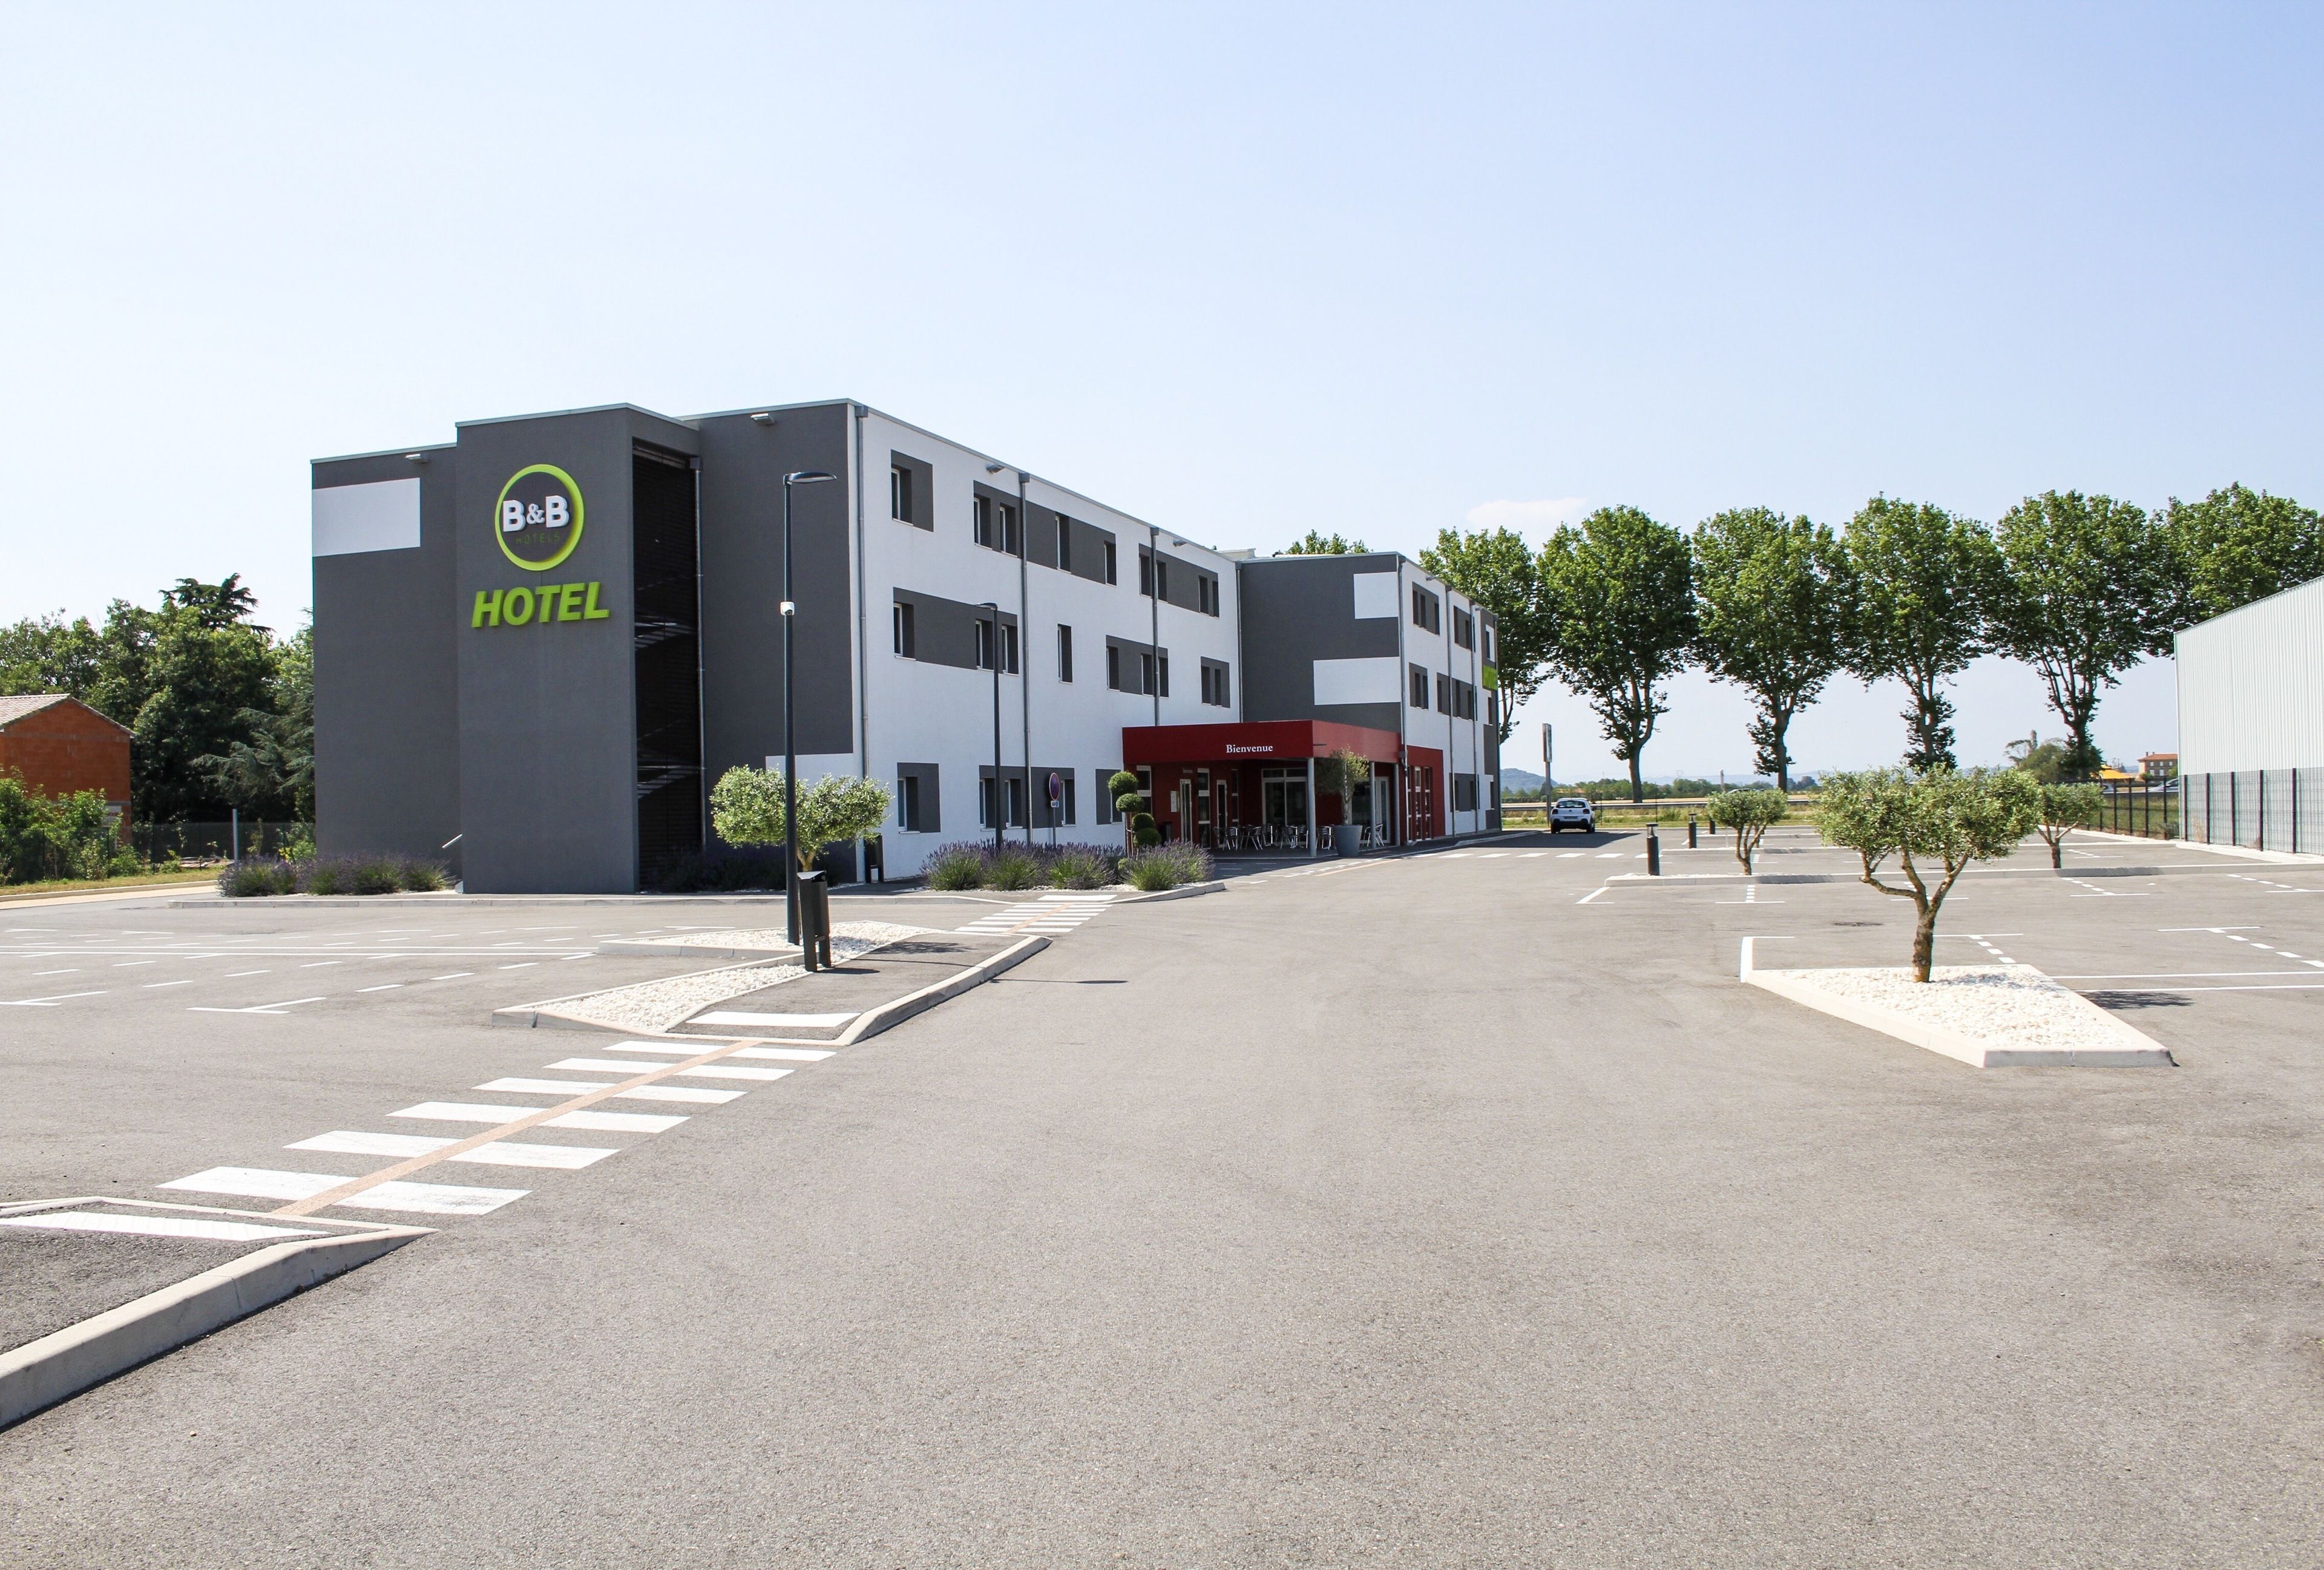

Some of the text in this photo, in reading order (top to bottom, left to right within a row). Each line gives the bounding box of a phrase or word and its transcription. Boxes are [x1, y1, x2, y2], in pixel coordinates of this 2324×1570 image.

[503, 495, 570, 532] B&B
[471, 581, 610, 628] HOTEL
[1226, 744, 1273, 754] Bienvenue
